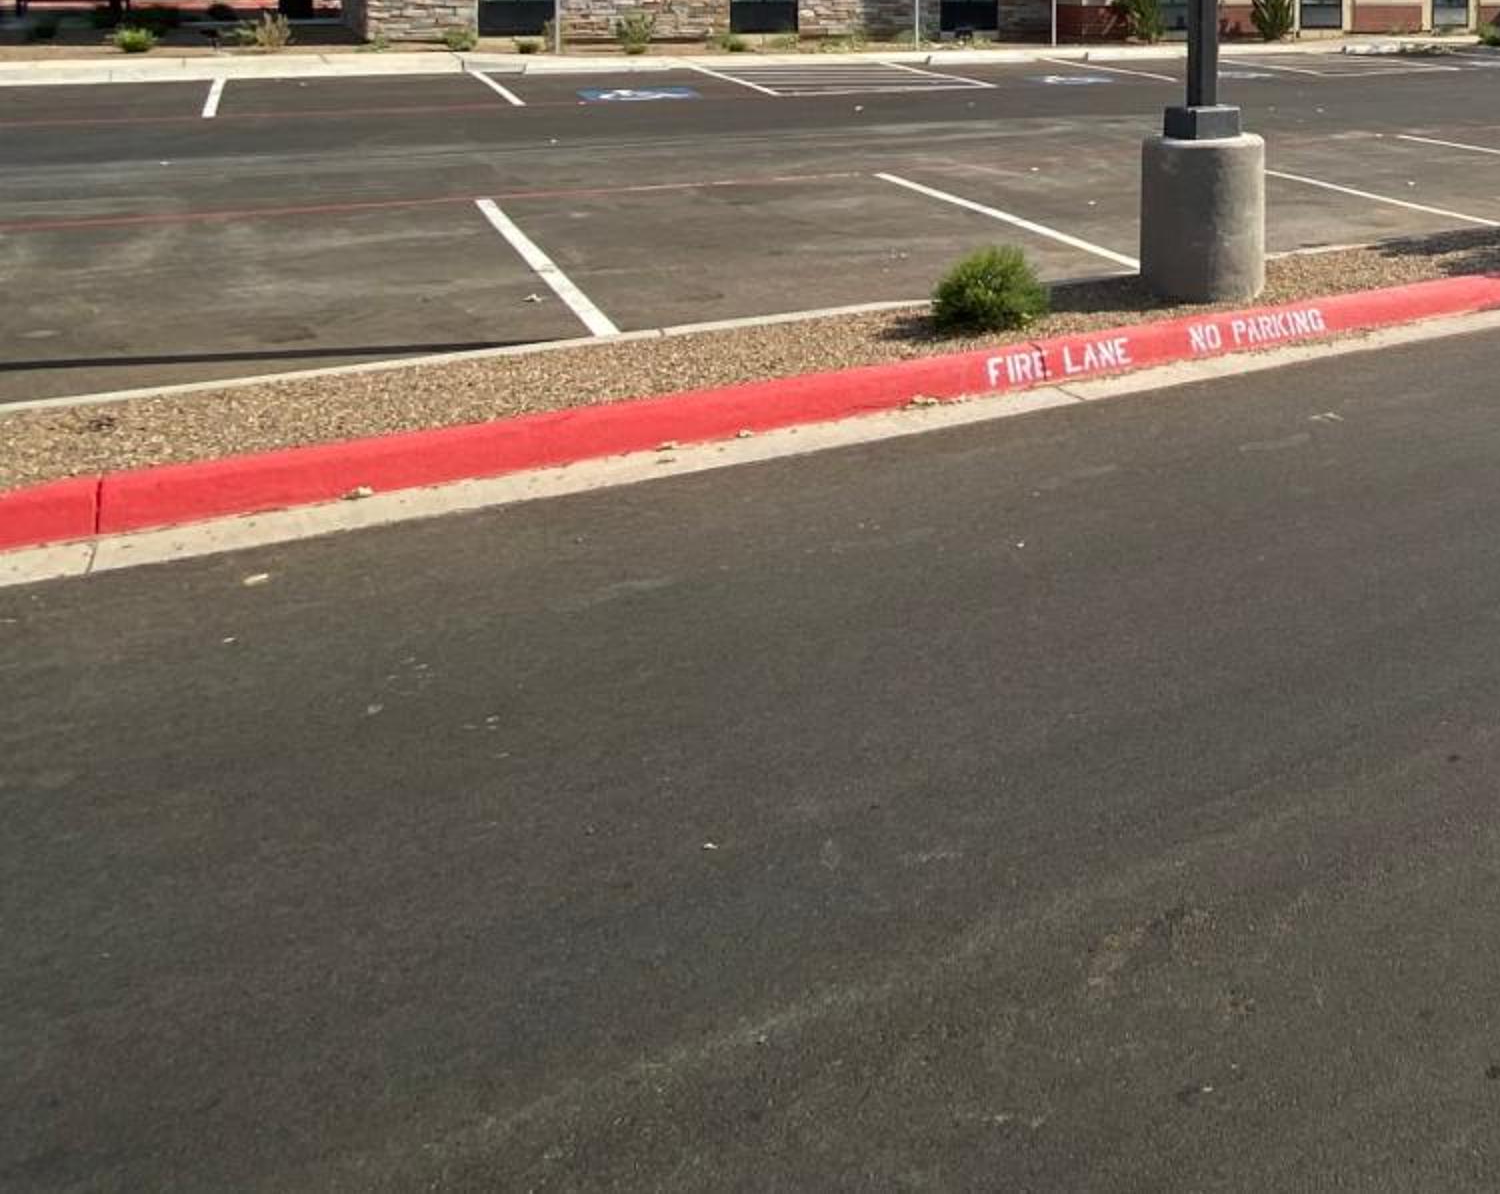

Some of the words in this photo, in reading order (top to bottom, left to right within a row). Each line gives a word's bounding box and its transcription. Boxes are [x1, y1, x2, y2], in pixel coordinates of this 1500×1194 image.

[986, 350, 1053, 387] FIRE
[1062, 337, 1132, 375] LANE
[1188, 323, 1222, 352] NO
[1231, 308, 1327, 344] PARKING
